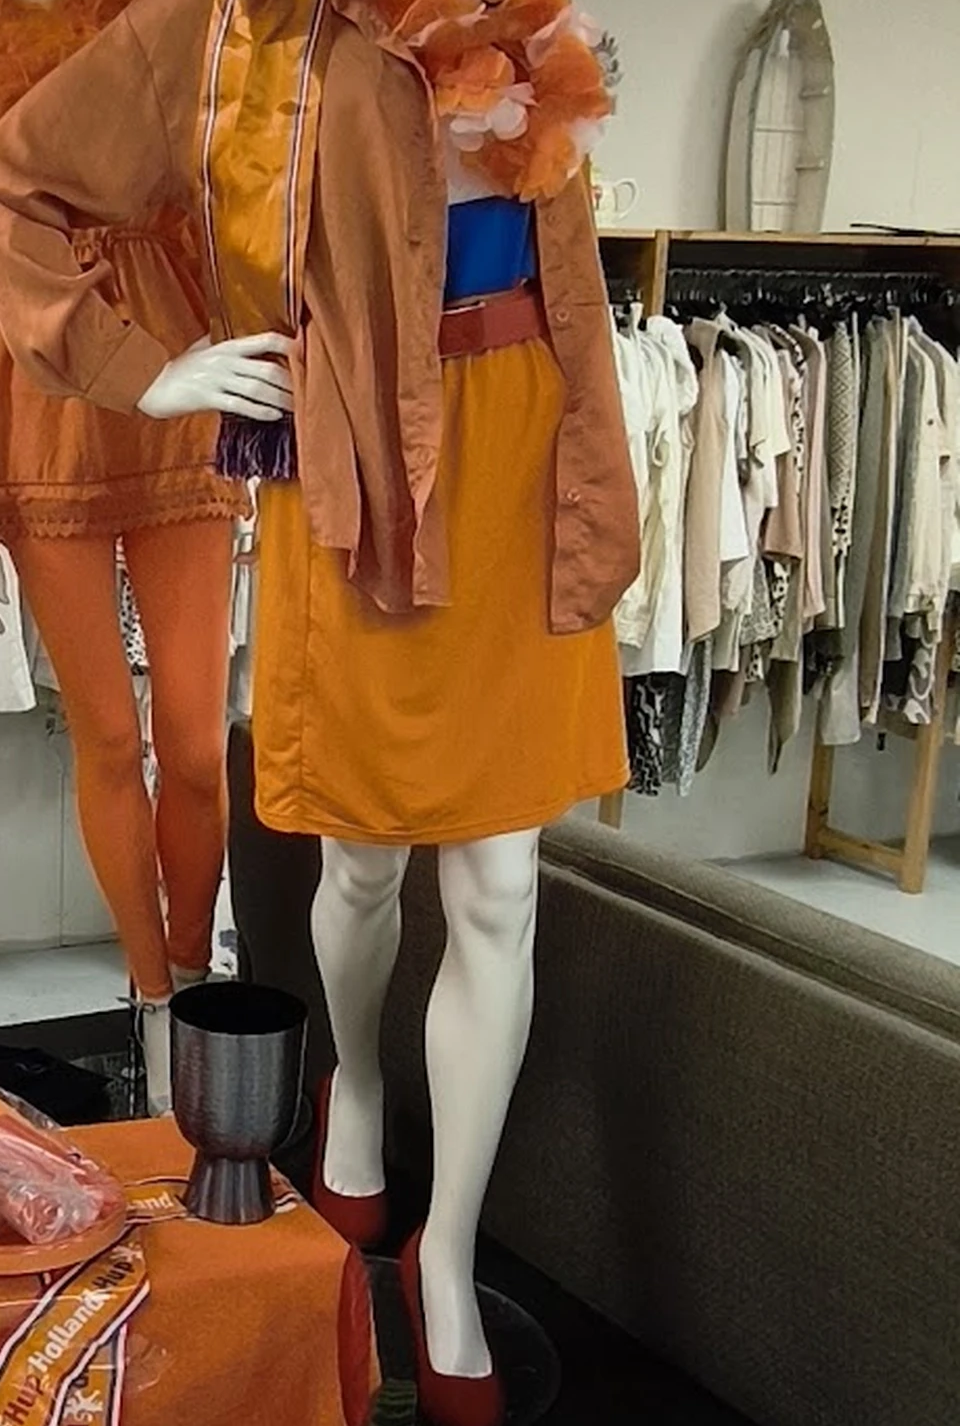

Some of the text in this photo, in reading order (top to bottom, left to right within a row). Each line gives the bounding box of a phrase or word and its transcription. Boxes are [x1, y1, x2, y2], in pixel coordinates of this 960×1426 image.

[4, 1370, 47, 1426] Hup
[27, 1289, 110, 1373] Holland
[92, 1261, 136, 1291] Hup
